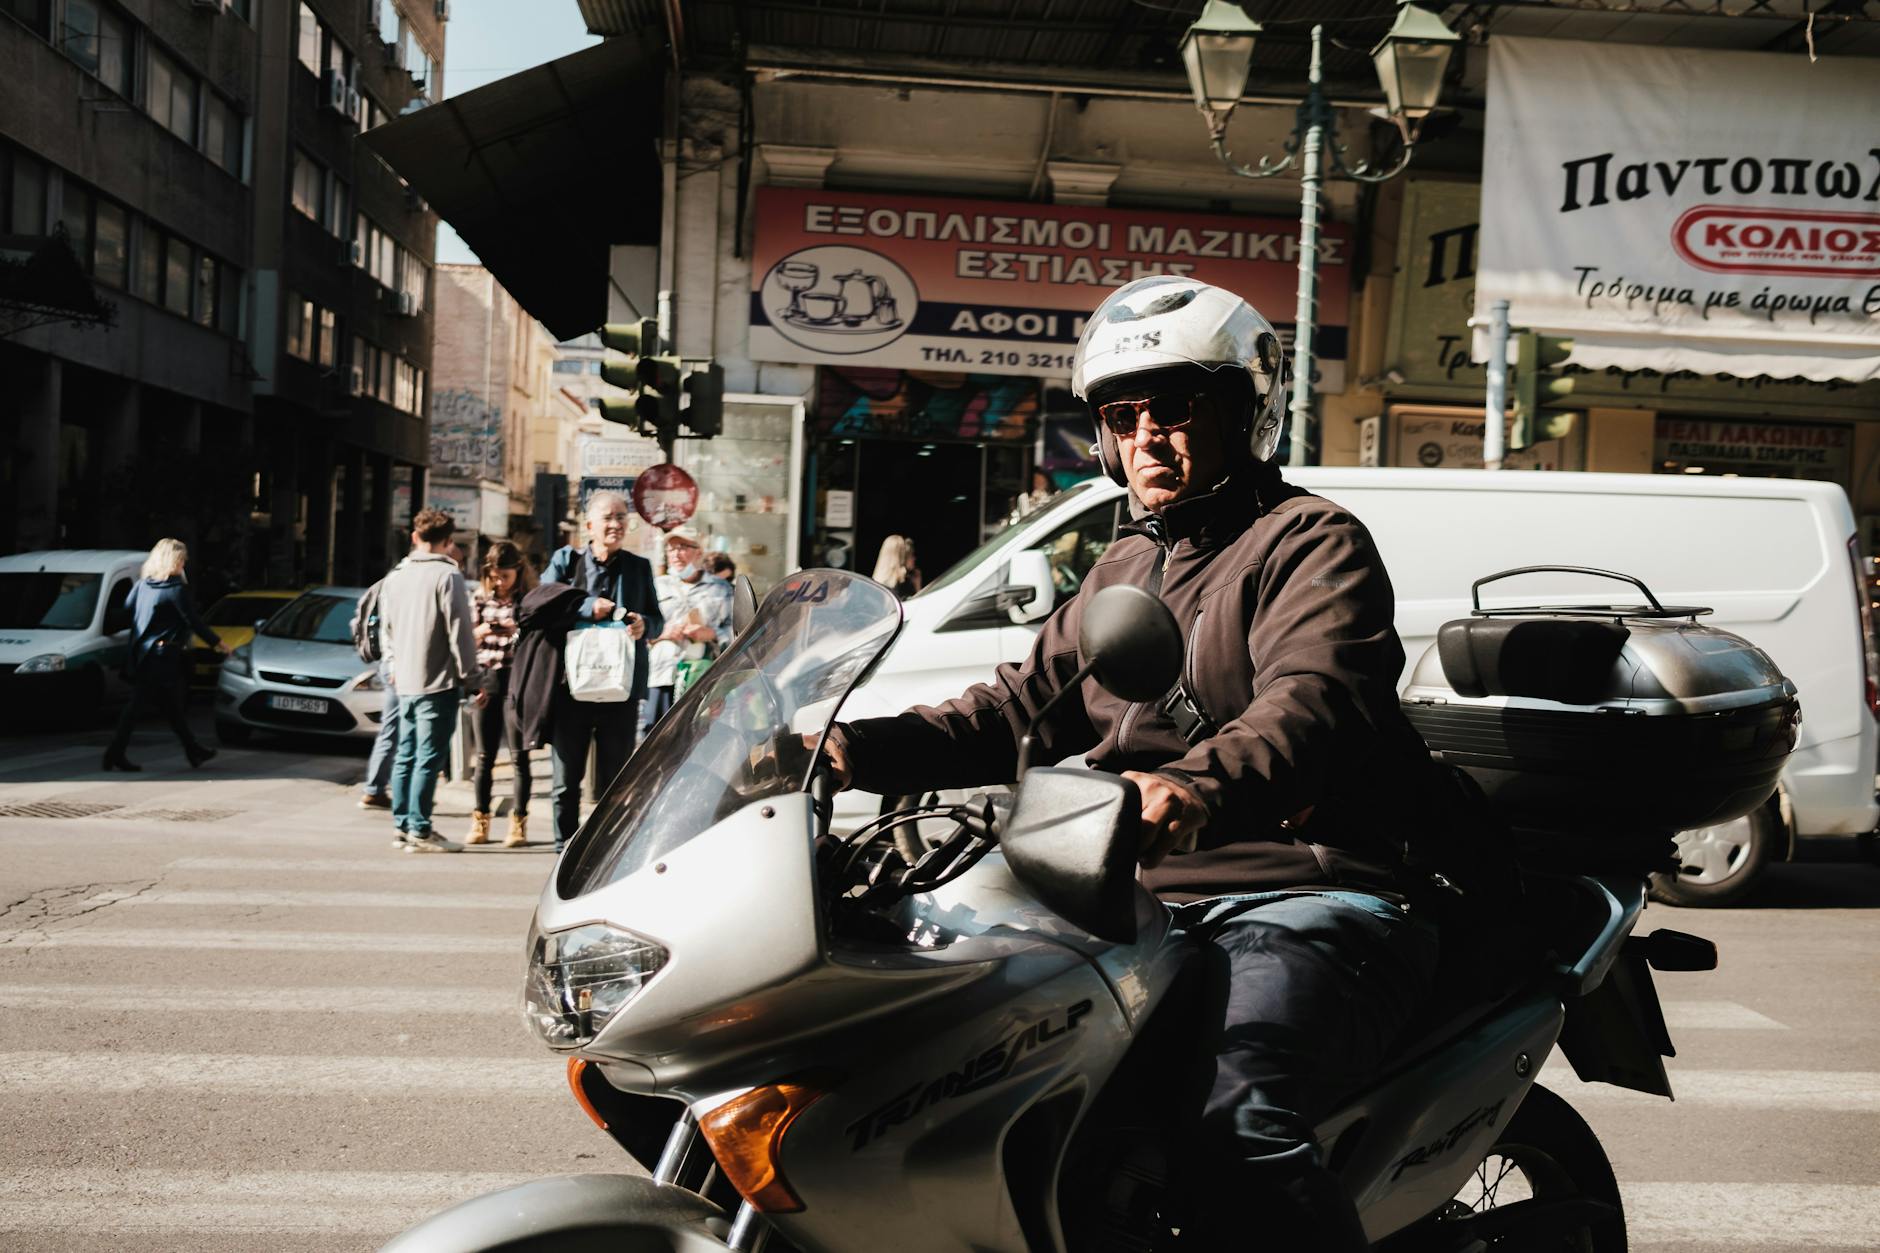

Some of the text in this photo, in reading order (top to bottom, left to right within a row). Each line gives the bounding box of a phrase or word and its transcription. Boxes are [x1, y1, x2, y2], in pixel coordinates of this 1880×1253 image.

[805, 204, 1345, 265] ΕΞΟΠΛΙΣΜΟΙ ΜΑΖΙΚΗΣ
[1705, 223, 1880, 254] ΚΟΛΙΟΣ
[1573, 266, 1693, 317] Τρόφιμα
[1704, 288, 1741, 320] με
[1751, 286, 1851, 326] άρωμα
[950, 310, 1059, 337] ΑΦΟΙ
[921, 347, 973, 364] ΤΗΛ.
[980, 350, 1020, 367] 210
[844, 997, 1095, 1152] TRANSALP
